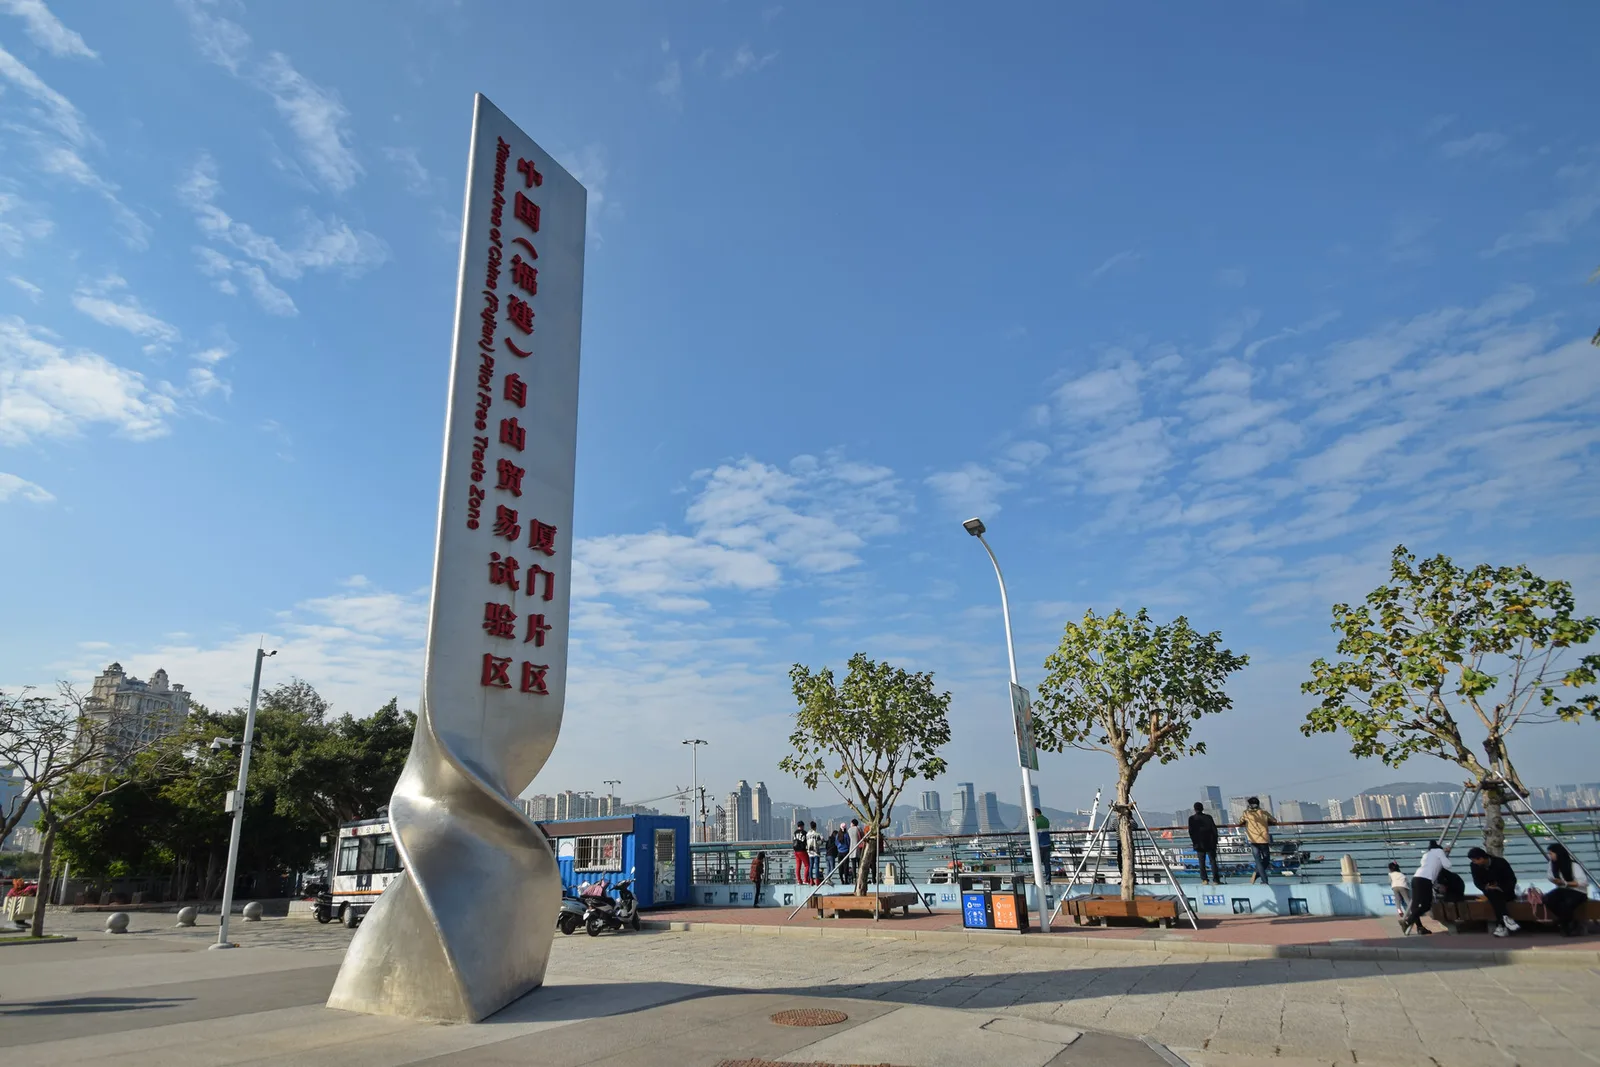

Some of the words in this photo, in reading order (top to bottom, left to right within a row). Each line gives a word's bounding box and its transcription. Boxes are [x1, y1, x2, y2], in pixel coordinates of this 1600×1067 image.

[494, 135, 511, 192] Xiamen
[491, 190, 507, 228] Area
[489, 227, 504, 248] of
[486, 245, 503, 290] China
[478, 290, 500, 352] (Fujian)
[478, 352, 495, 392] Pilot
[474, 391, 492, 431] Free
[470, 435, 489, 483] Trade
[466, 484, 486, 530] Zone
[520, 518, 557, 696] 厦门片区
